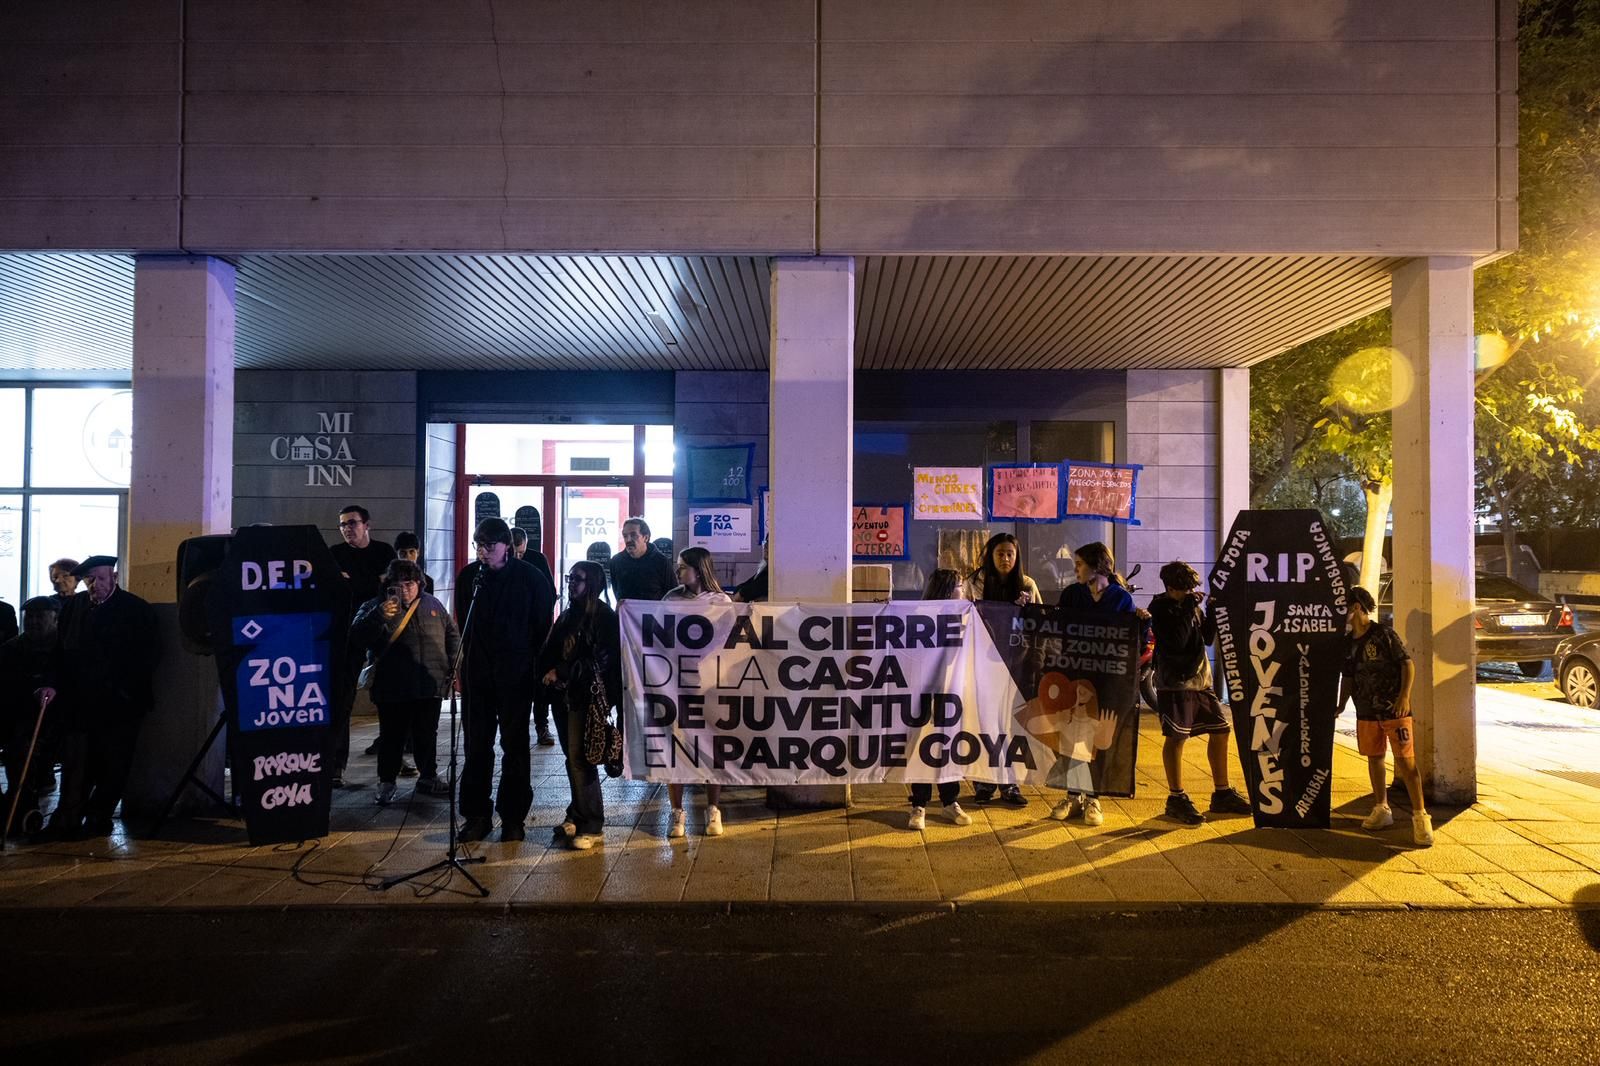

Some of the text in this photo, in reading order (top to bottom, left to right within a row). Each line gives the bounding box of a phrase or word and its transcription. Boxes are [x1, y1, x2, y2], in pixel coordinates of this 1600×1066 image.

[317, 412, 354, 434] MI
[304, 464, 356, 486] INN
[917, 473, 959, 484] MENOS
[1069, 468, 1097, 479] ZONA
[584, 527, 607, 535] NA
[713, 522, 733, 530] NA
[855, 543, 902, 555] CIERRA
[1212, 529, 1251, 591] LA JOTA
[241, 559, 316, 591] D.E.P.
[1247, 552, 1321, 583] R.I.P.
[1309, 521, 1348, 615] CASABLANCA
[1287, 603, 1333, 617] SANTA
[642, 613, 963, 651] NO AL CIERRE
[1012, 617, 1130, 641] NO AL CIERRE
[1283, 618, 1337, 633] ISABEL
[1009, 633, 1129, 657] DE LAS ZONAS
[1215, 606, 1245, 702] MIRALBUENO
[642, 653, 908, 691] DE LA CASA
[268, 682, 327, 710] NA
[1296, 643, 1312, 768] VALDEFIERRO
[643, 693, 963, 731] DE JUVENTUD
[253, 751, 322, 781] PARQUE
[644, 732, 1037, 777] EN PARQUE GOYA
[260, 782, 313, 810] GOYA
[1295, 767, 1330, 818] ARRABAL
